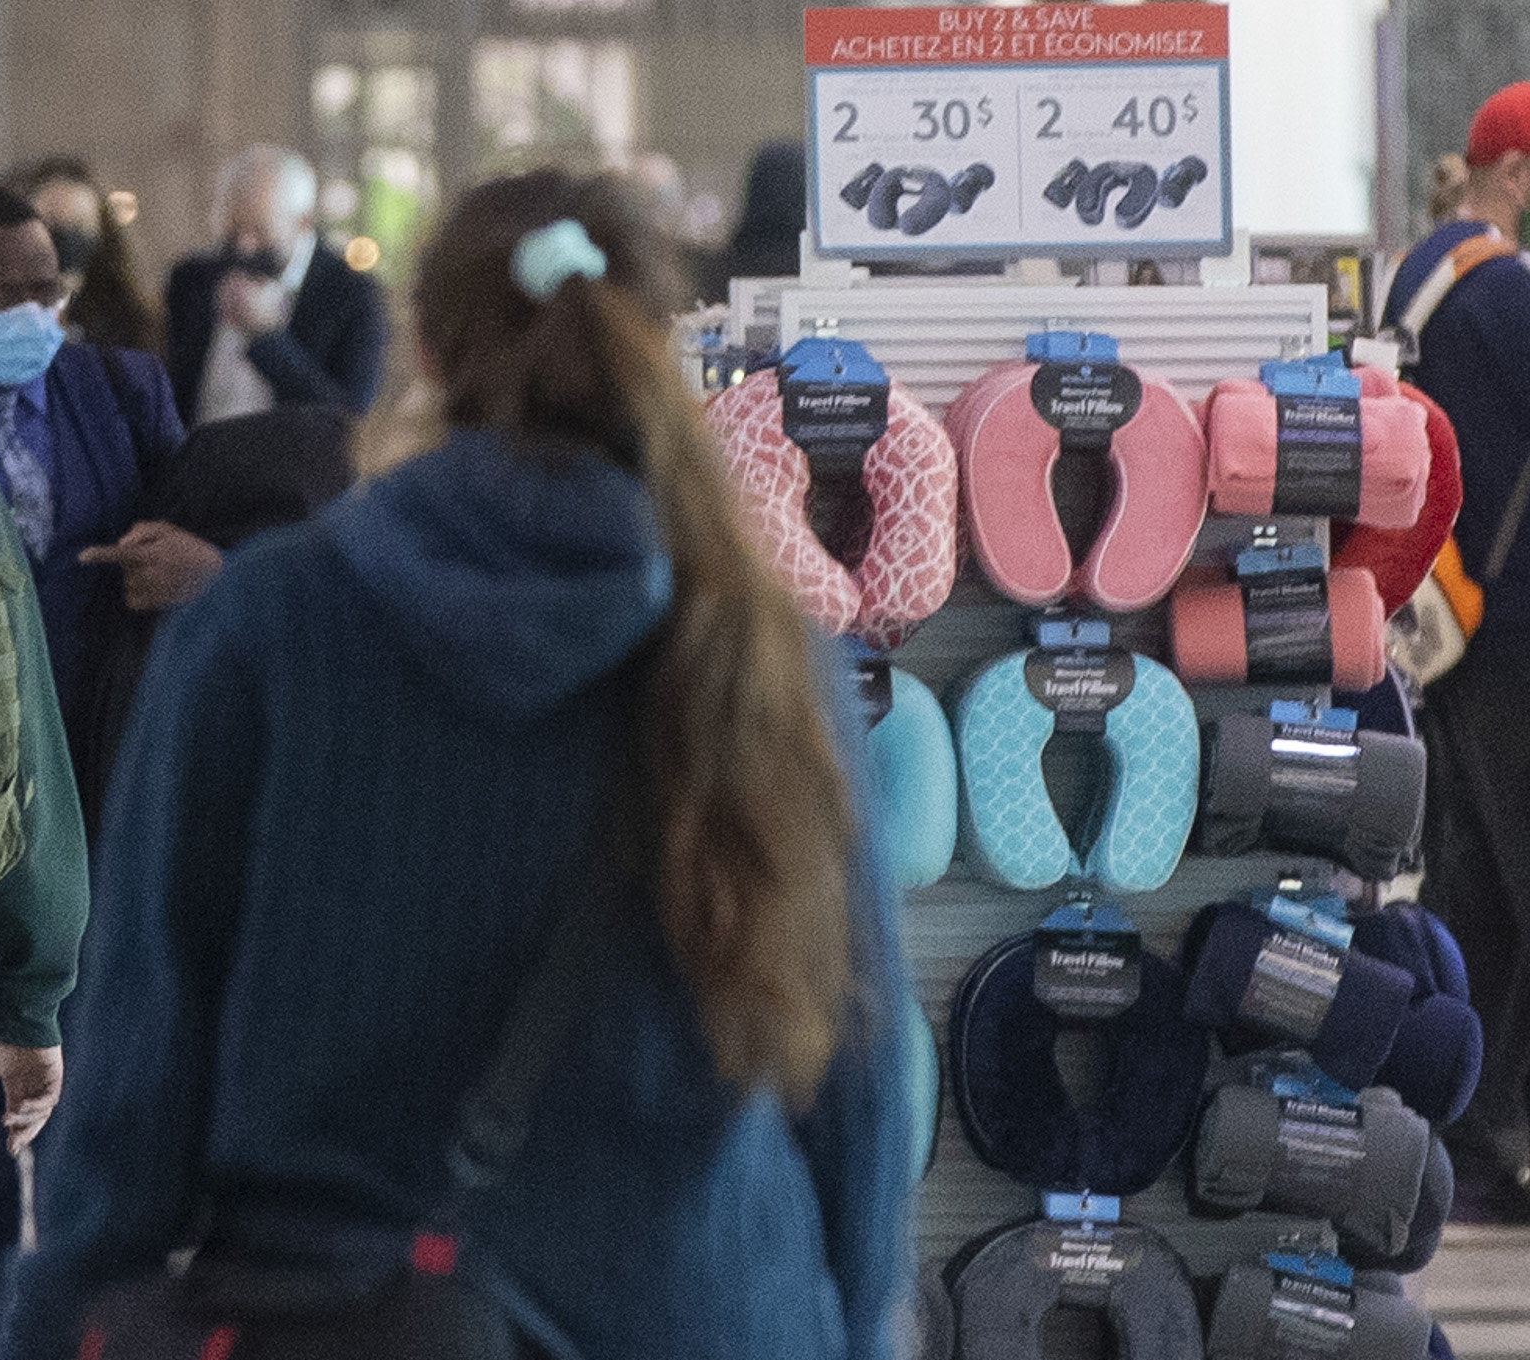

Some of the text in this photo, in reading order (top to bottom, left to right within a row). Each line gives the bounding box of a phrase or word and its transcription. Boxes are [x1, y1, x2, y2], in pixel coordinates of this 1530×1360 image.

[939, 7, 1095, 32] BUY 2 & SAVE
[831, 27, 1204, 60] ACHETEZ-EN 2 ET ÉCONOMISEZ
[833, 100, 860, 142] 2
[1037, 96, 1063, 139] 2
